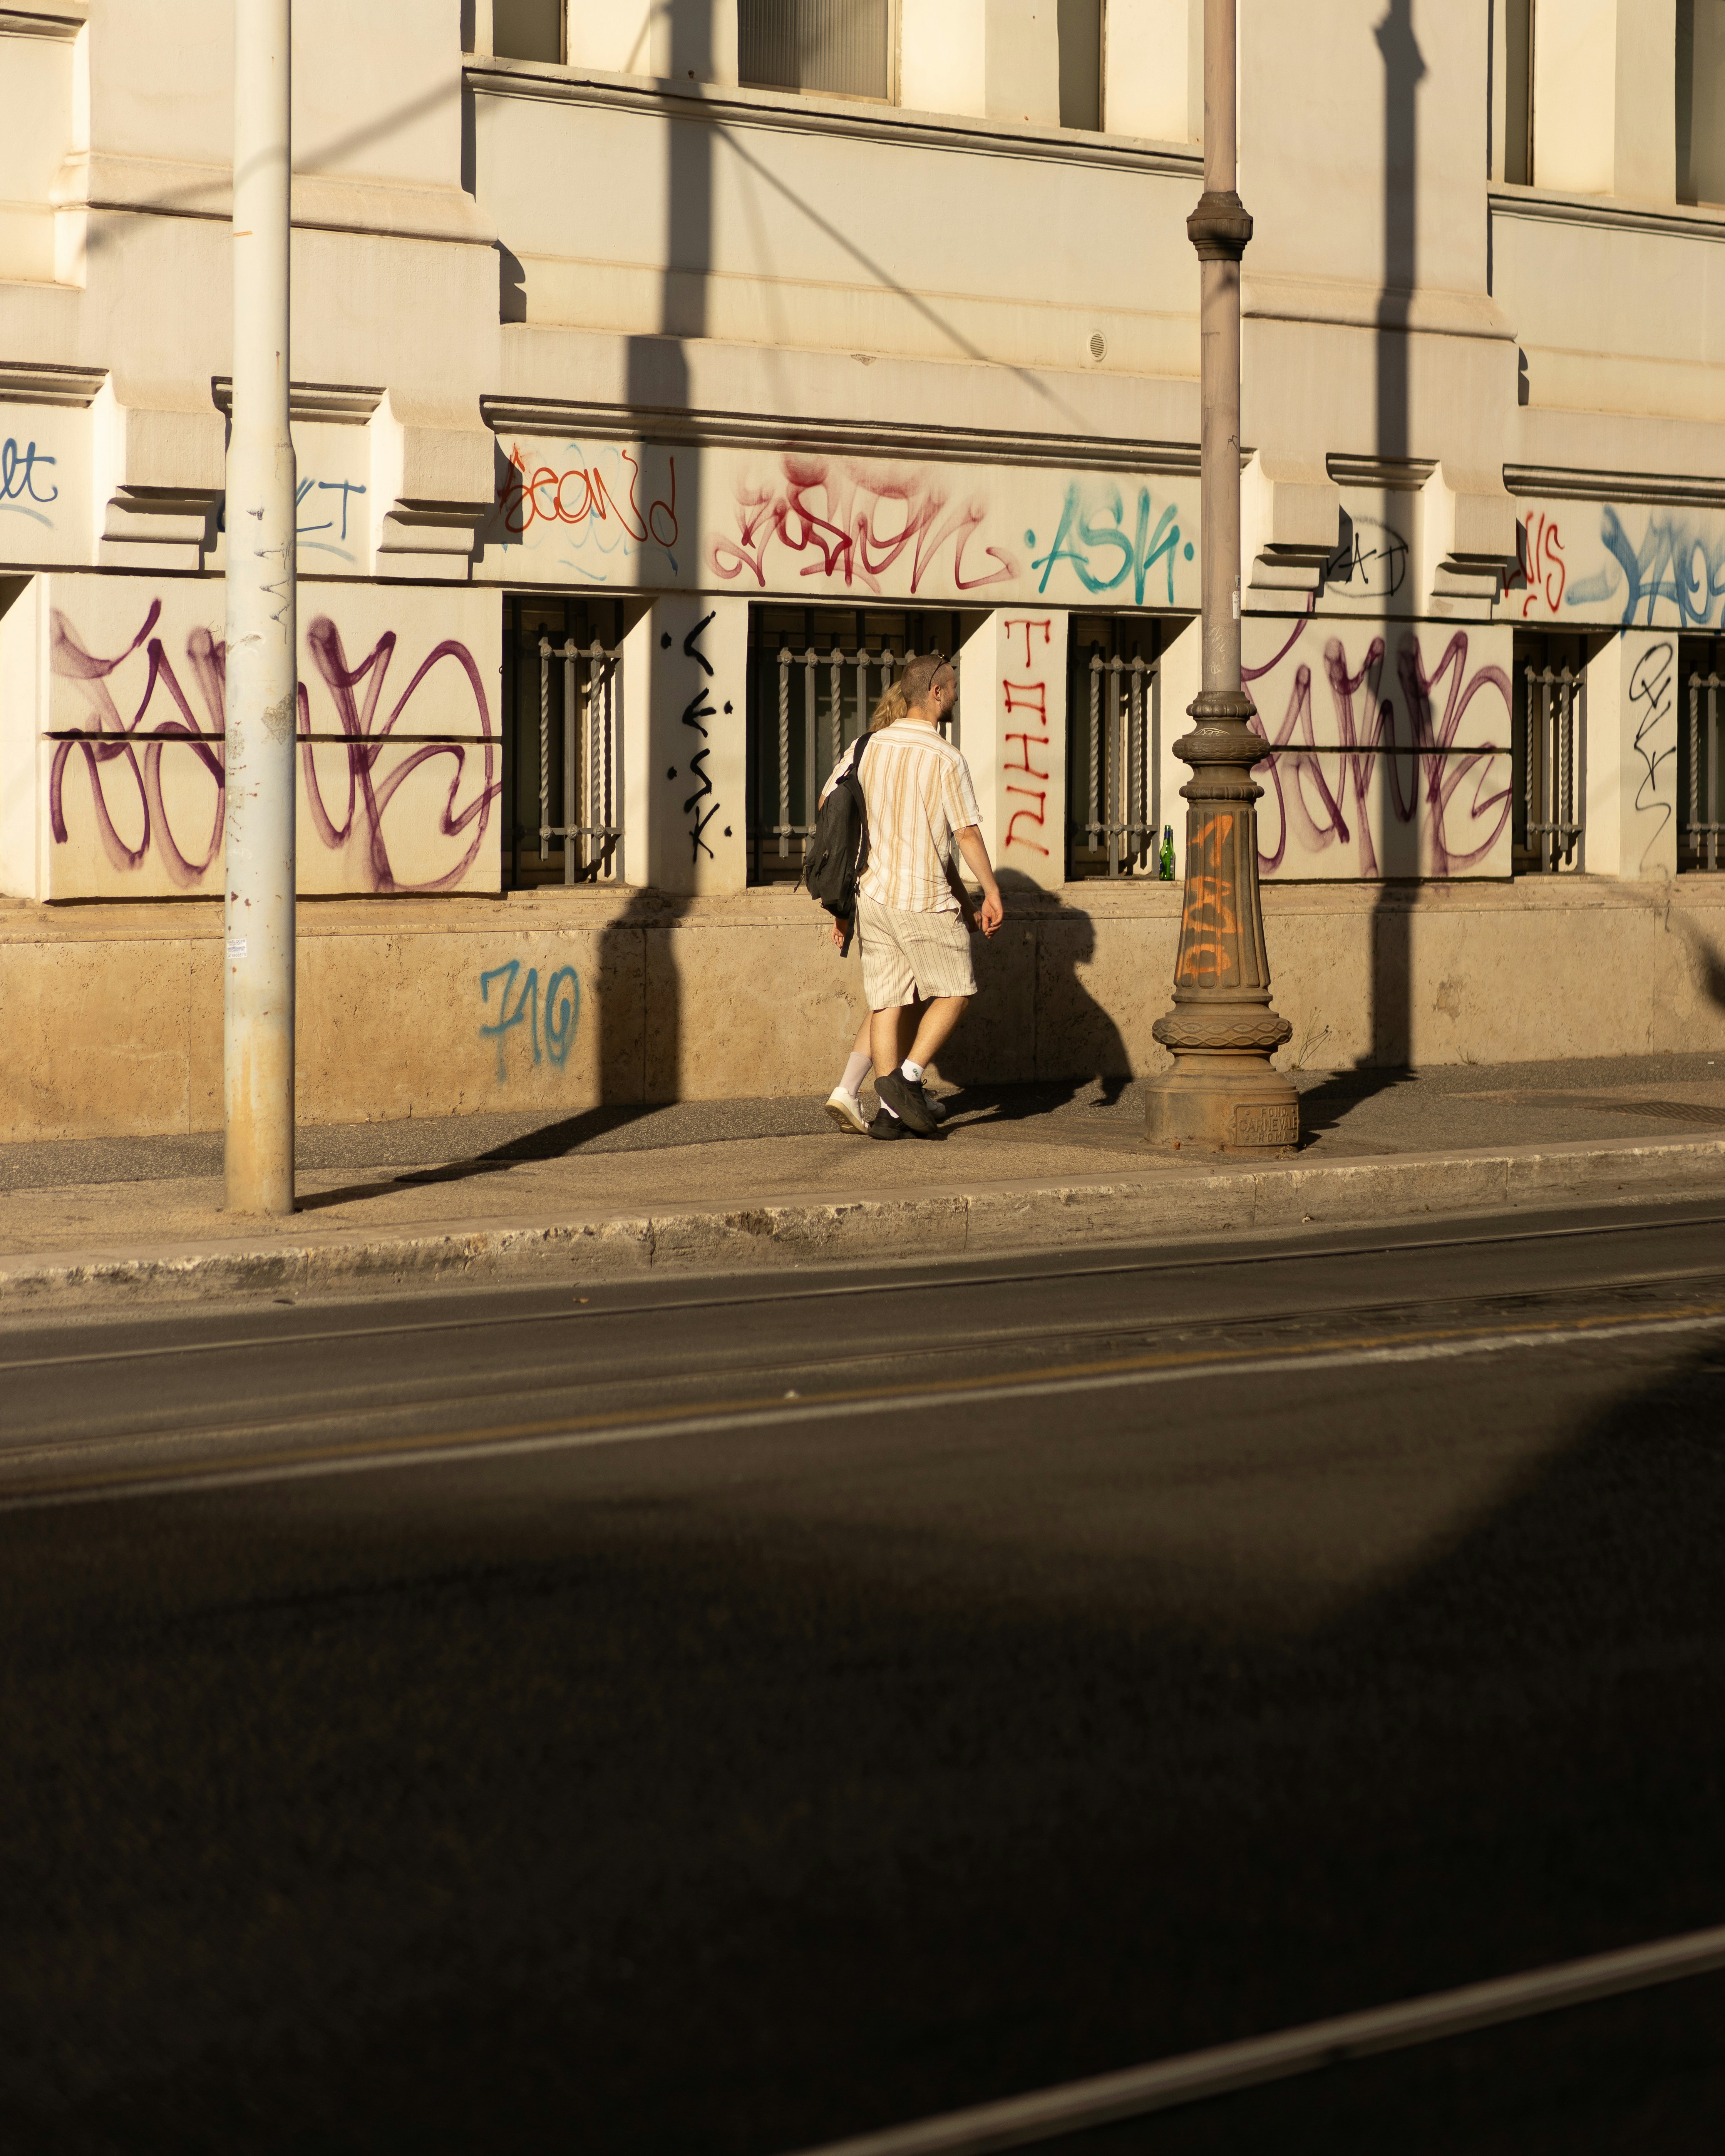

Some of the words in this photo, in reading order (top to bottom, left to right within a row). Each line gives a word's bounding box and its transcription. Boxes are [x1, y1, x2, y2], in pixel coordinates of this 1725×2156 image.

[1031, 483, 1181, 606] ASK
[1260, 1106, 1289, 1118] FOND.
[1238, 1116, 1298, 1133] CARNEVALE
[1257, 1131, 1288, 1143] ROMA
